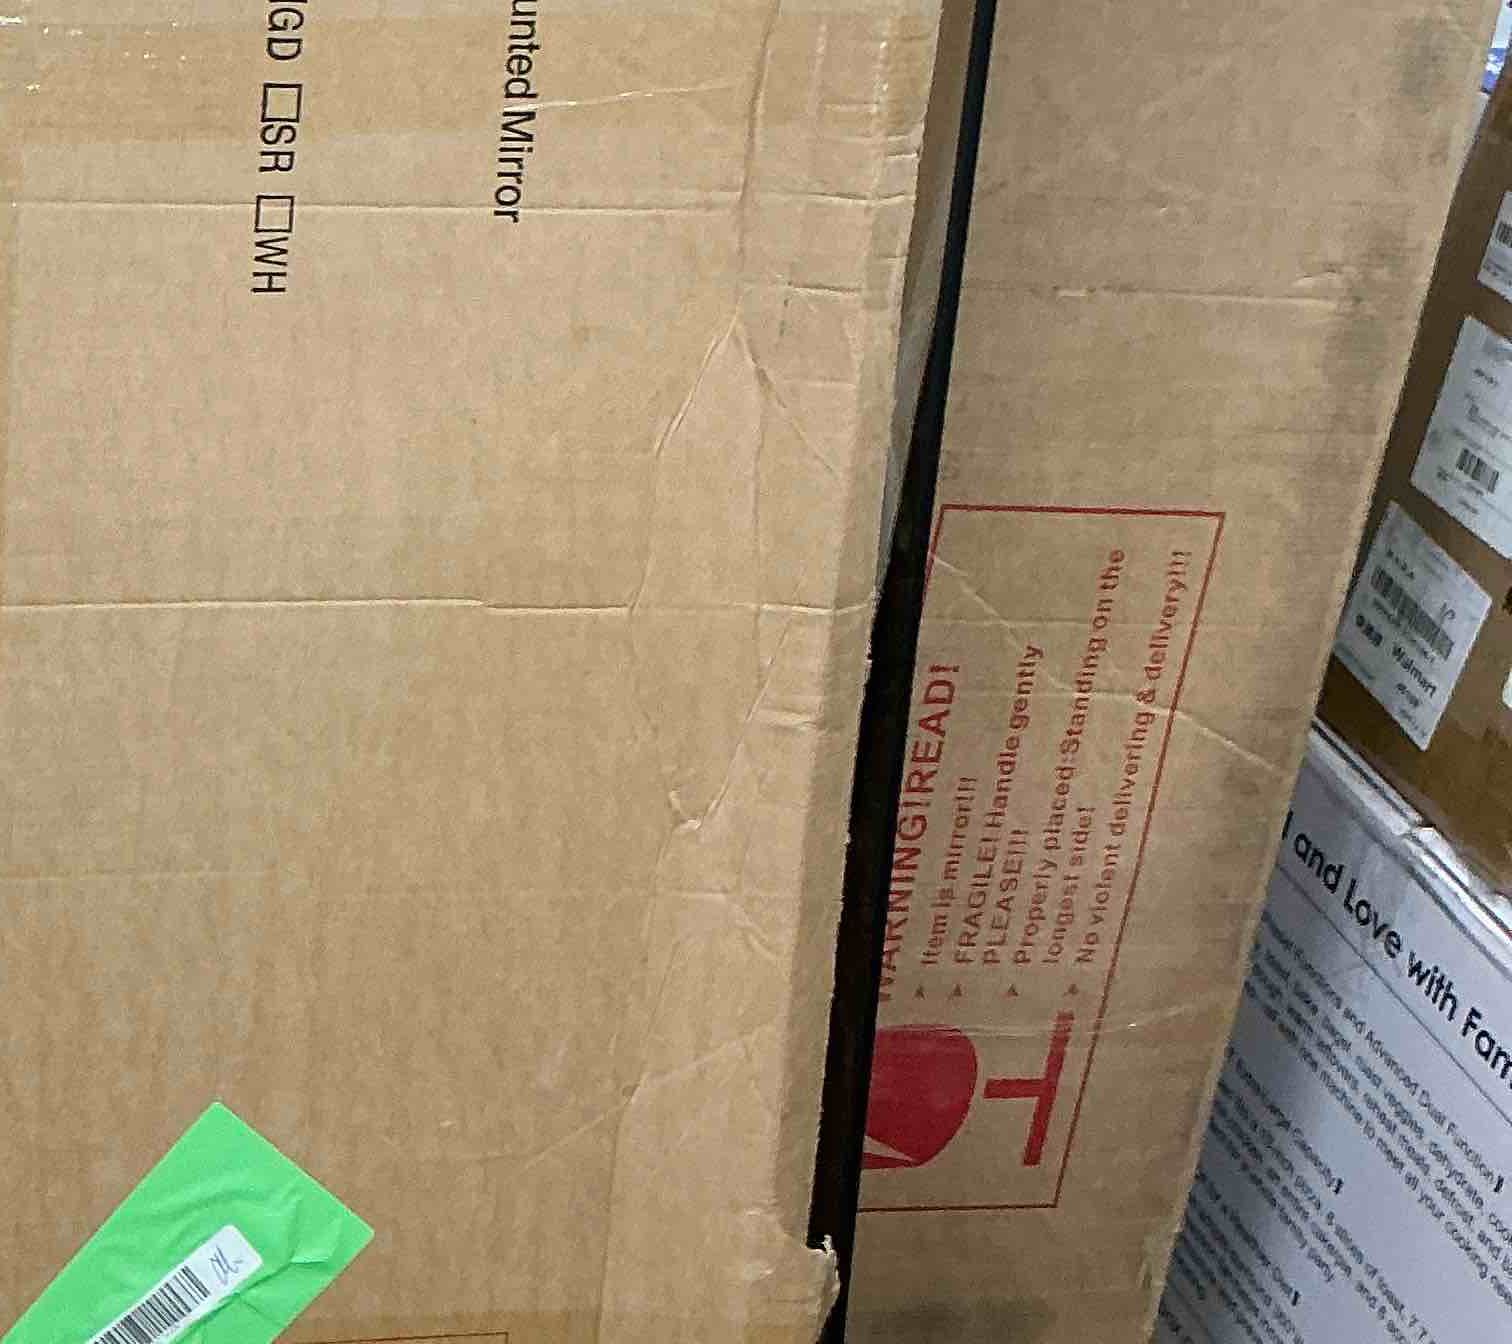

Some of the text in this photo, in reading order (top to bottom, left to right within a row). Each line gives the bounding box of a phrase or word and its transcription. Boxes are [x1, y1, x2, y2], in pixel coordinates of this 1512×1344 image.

[266, 7, 304, 62] GD
[259, 123, 296, 174] SR
[493, 110, 536, 224] Mirror
[251, 235, 289, 294] WH
[1101, 548, 1127, 593] the
[1091, 595, 1115, 634] on
[1059, 636, 1099, 754] Standing
[1392, 640, 1438, 699] Walmart
[985, 731, 1020, 827] Handle
[1009, 642, 1046, 730] gently
[1075, 930, 1102, 966] No
[1092, 846, 1125, 925] violent
[1110, 710, 1157, 838] delivering
[1012, 858, 1059, 967] Properly
[1040, 806, 1096, 967] longest side!
[1293, 832, 1345, 894] and
[1343, 878, 1403, 959] Love
[1407, 950, 1457, 1022] with
[920, 915, 949, 966] Item
